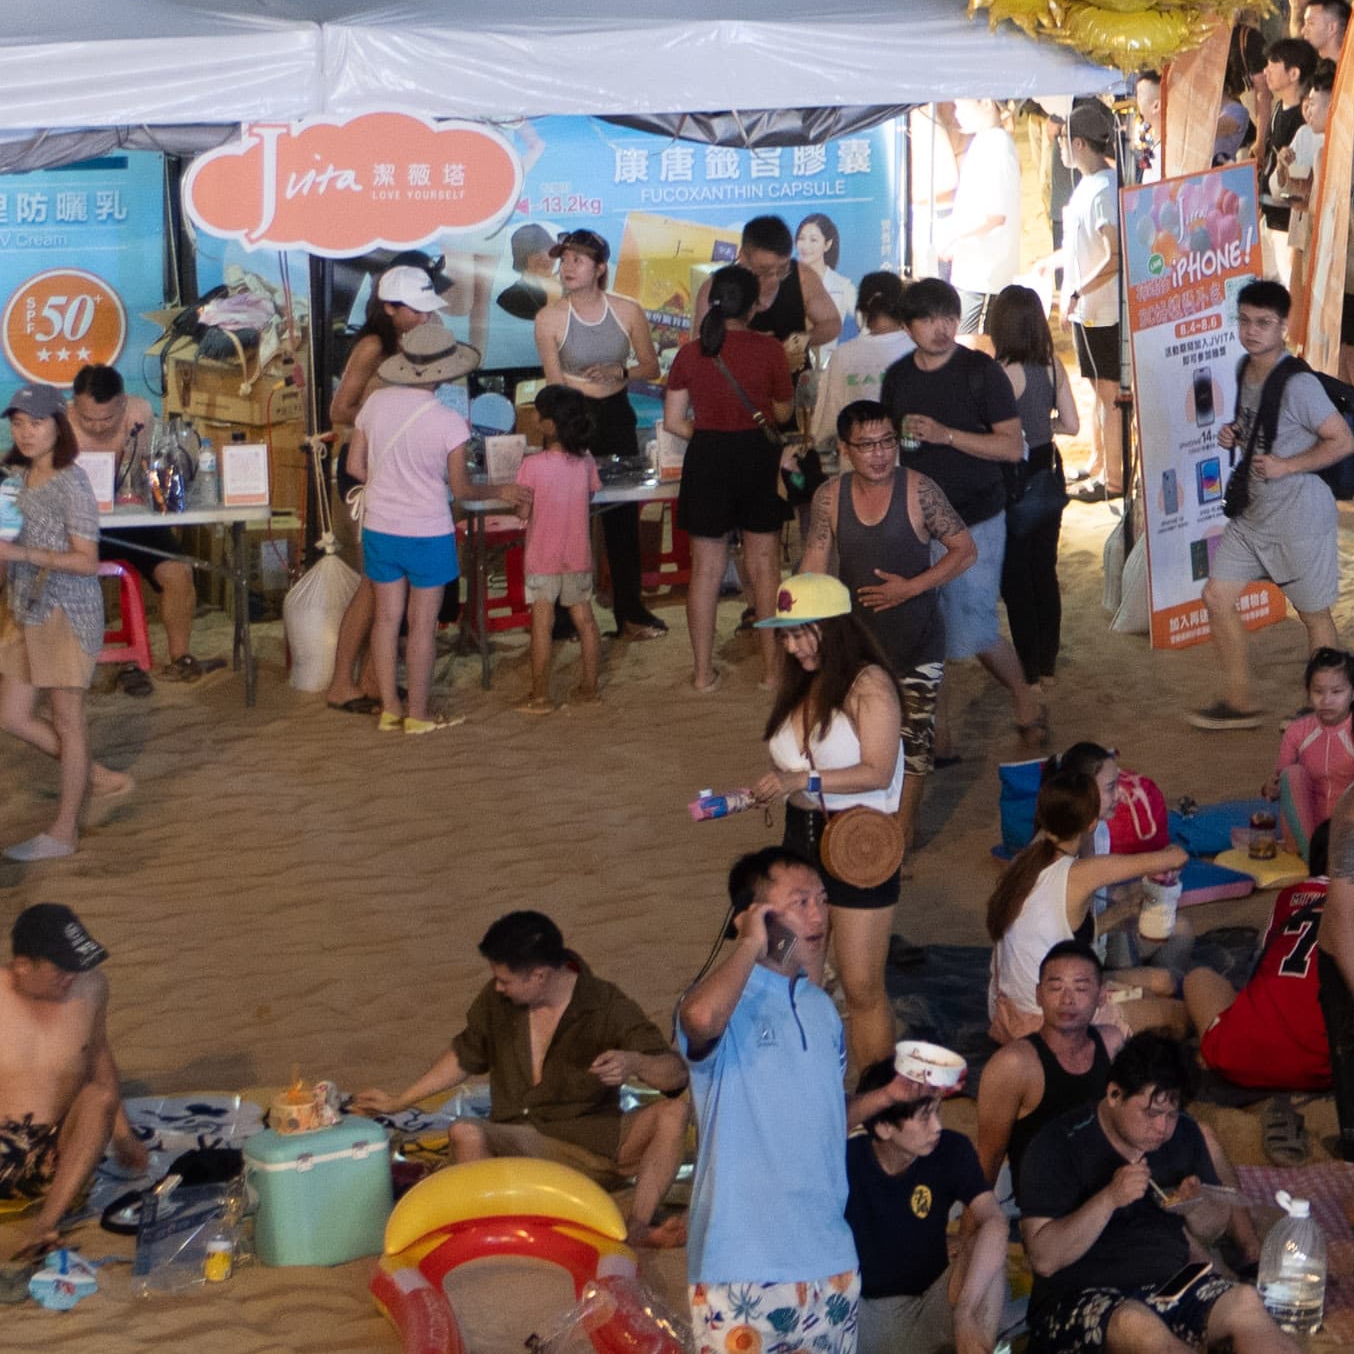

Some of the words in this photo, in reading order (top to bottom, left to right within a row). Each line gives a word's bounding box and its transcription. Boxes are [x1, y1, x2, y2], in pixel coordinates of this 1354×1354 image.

[372, 190, 400, 200] LOVE
[406, 189, 466, 201] YOURSELF
[640, 186, 765, 204] FUCOXANTHIN
[767, 179, 846, 198] CAPSULE
[15, 232, 68, 247] Cream
[26, 296, 37, 335] SPF
[1278, 908, 1323, 978] 7
